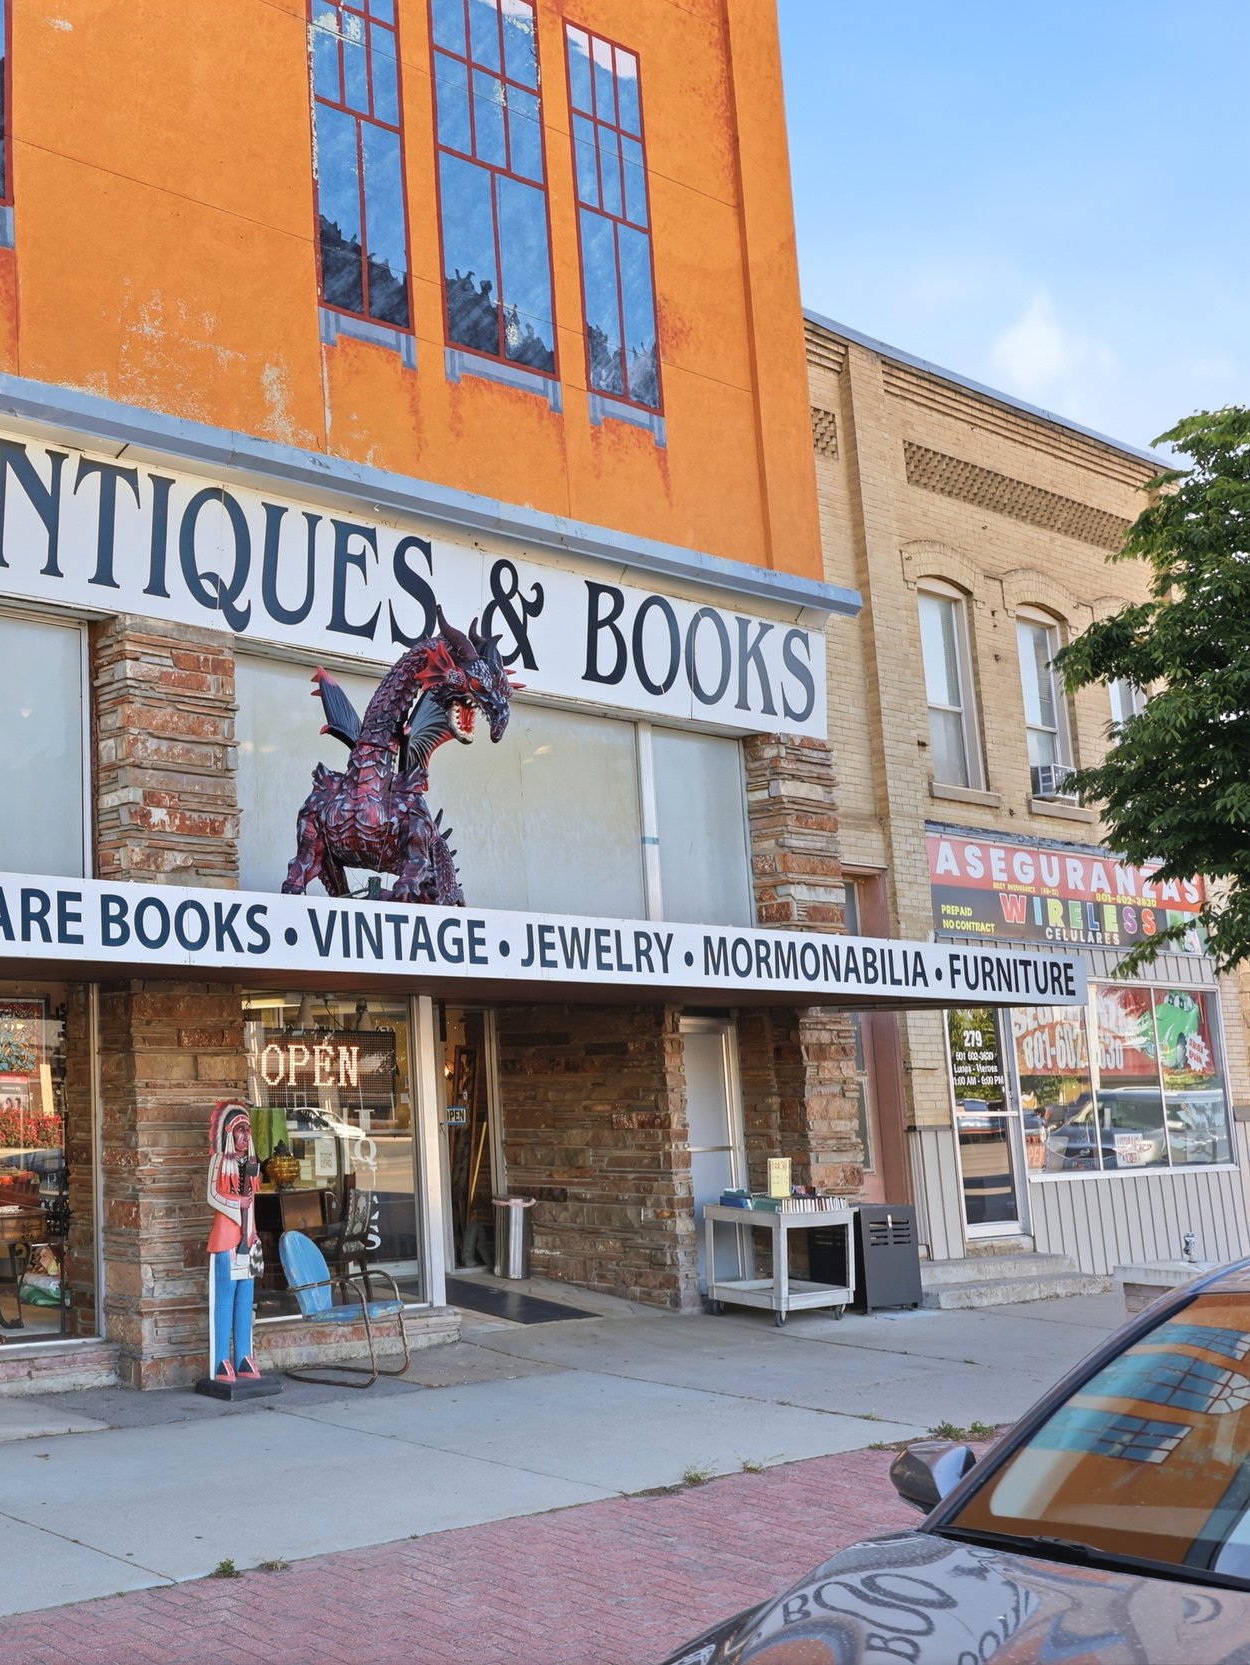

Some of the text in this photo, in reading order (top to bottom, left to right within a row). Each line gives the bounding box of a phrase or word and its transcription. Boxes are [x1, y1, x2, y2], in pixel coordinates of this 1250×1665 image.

[480, 559, 544, 671] &
[581, 580, 816, 723] BOOKS
[941, 904, 973, 917] PREPAID
[999, 893, 1156, 936] WIRELESS
[943, 919, 995, 933] NO CONTRACT
[1045, 927, 1120, 945] CELULARES
[101, 894, 271, 955] BOOKS
[307, 908, 488, 965] VINTAGE
[521, 923, 673, 973] JEWELRY
[704, 935, 928, 988] MORMONABILIA
[950, 954, 1077, 996] FURNITURE
[963, 1030, 983, 1047] 279
[261, 1044, 359, 1087] OPEN
